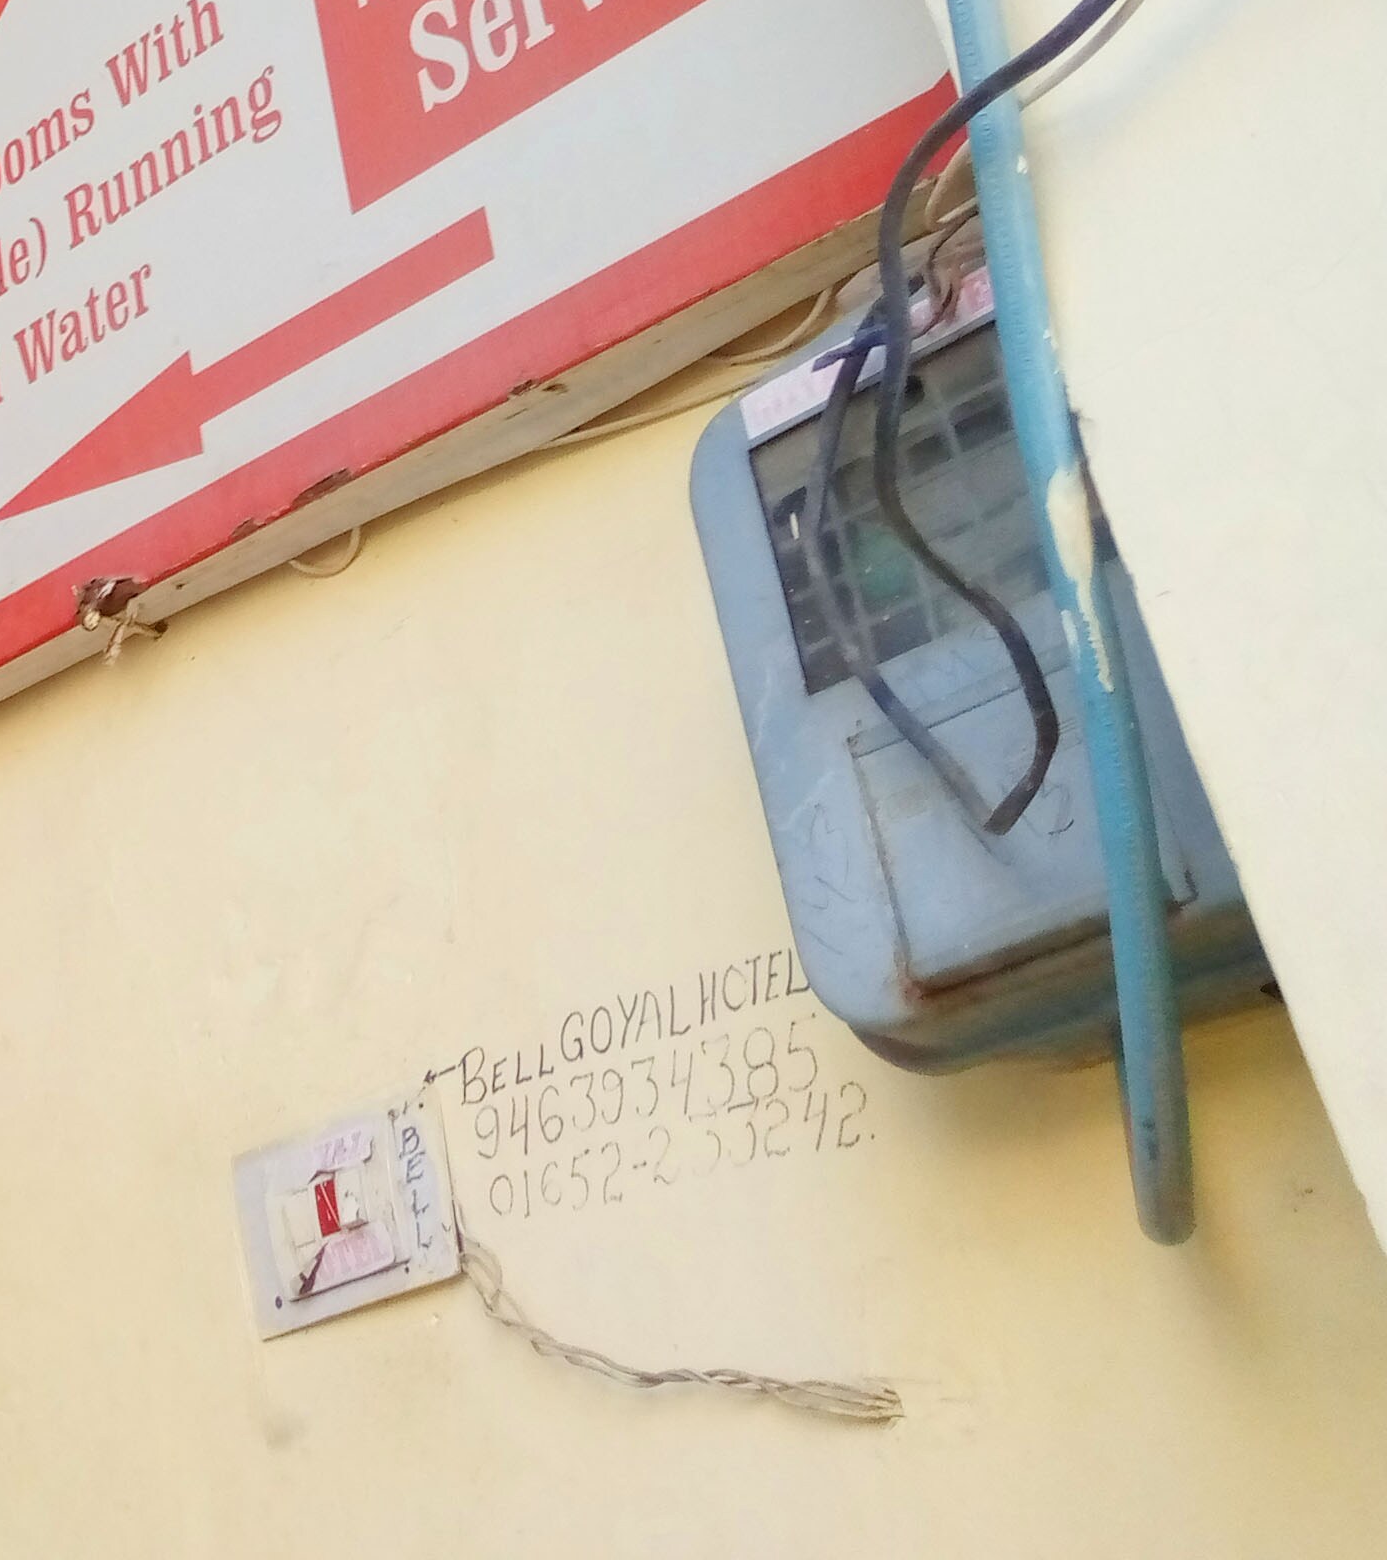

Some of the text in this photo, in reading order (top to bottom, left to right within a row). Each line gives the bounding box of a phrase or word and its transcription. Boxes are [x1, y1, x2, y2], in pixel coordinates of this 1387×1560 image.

[64, 66, 282, 249] Running
[13, 264, 152, 385] Water
[458, 948, 810, 1106] BELL GOYAL HOTEL
[474, 1014, 818, 1158] 9463934385
